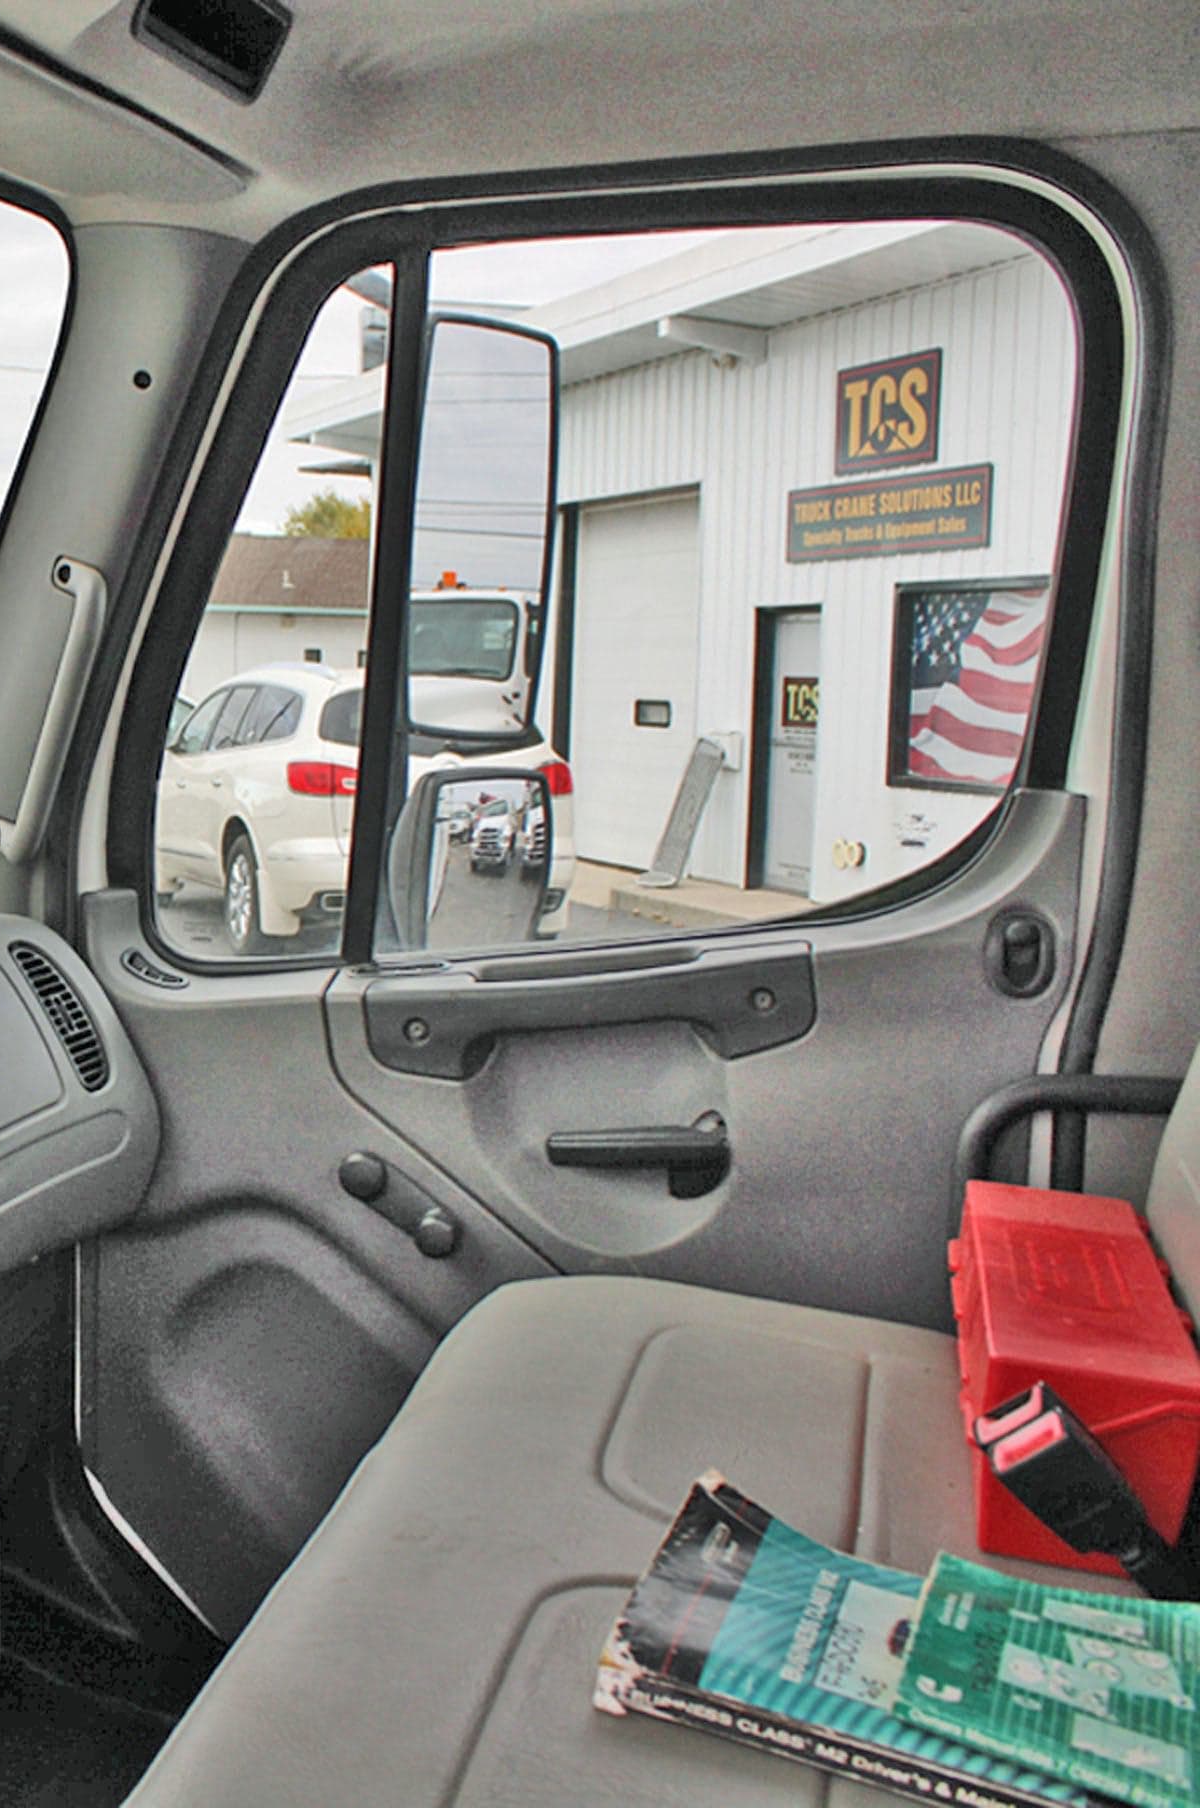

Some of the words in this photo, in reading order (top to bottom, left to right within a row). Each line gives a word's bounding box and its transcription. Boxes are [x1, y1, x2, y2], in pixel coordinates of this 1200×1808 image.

[845, 367, 928, 458] TCS
[795, 500, 831, 524] TRUCK
[834, 494, 877, 521] CRANE
[879, 484, 953, 515] SOLUTIONS
[955, 480, 981, 508] LLC
[815, 1742, 849, 1765] M2
[851, 1753, 932, 1793] Driver's
[934, 1780, 953, 1799] &
